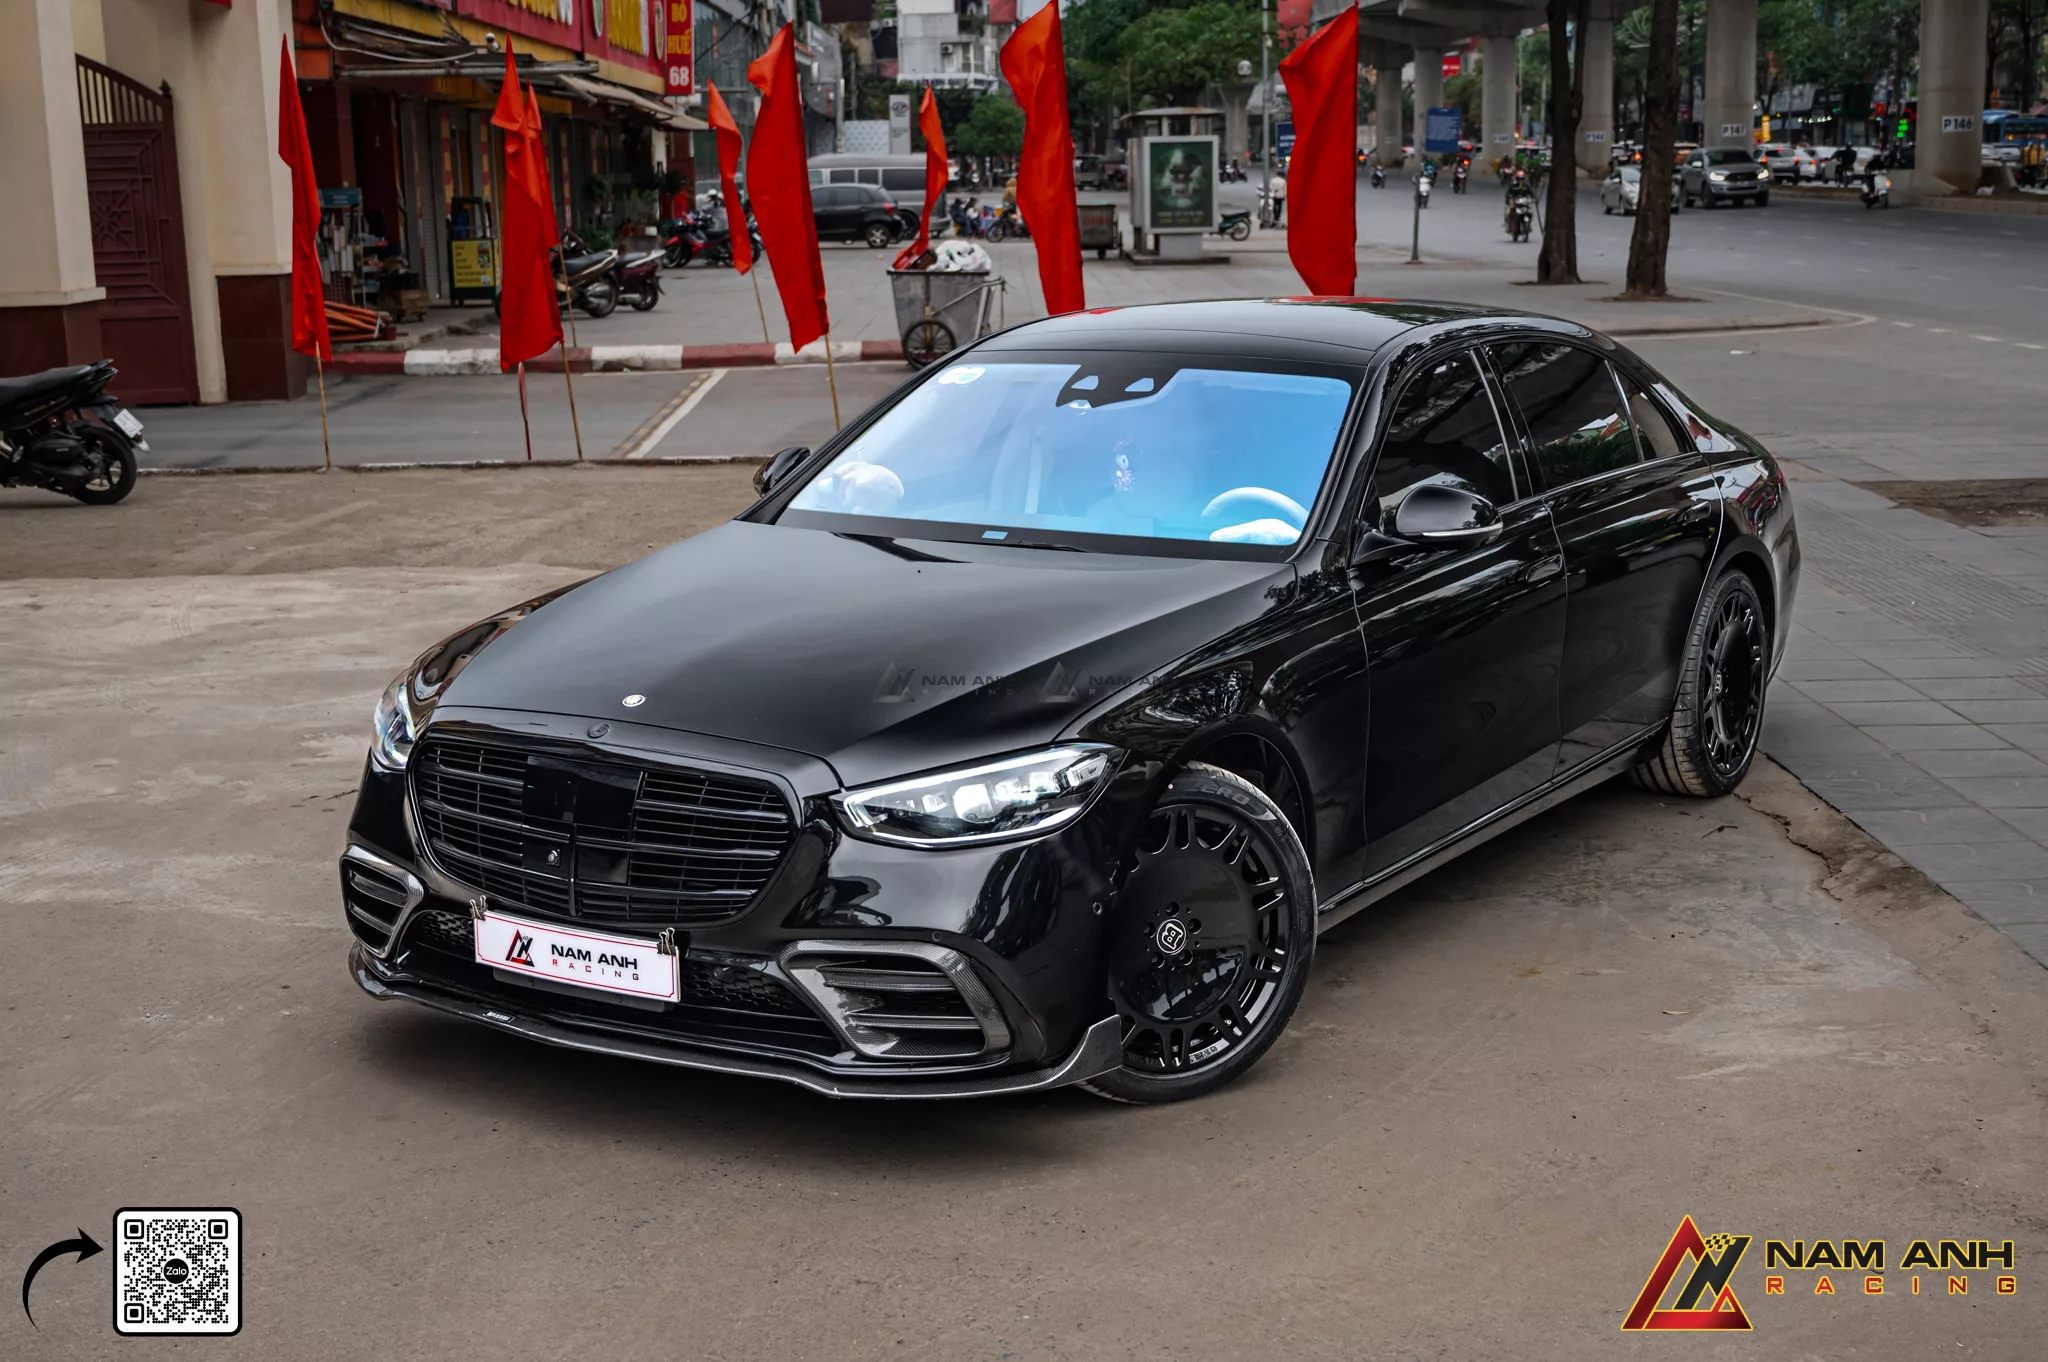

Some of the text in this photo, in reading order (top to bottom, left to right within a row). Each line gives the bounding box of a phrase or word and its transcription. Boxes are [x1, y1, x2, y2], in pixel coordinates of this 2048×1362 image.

[667, 27, 692, 55] HUẾ
[669, 66, 690, 87] 68
[551, 944, 638, 969] NAM ANH
[552, 958, 639, 981] RACING
